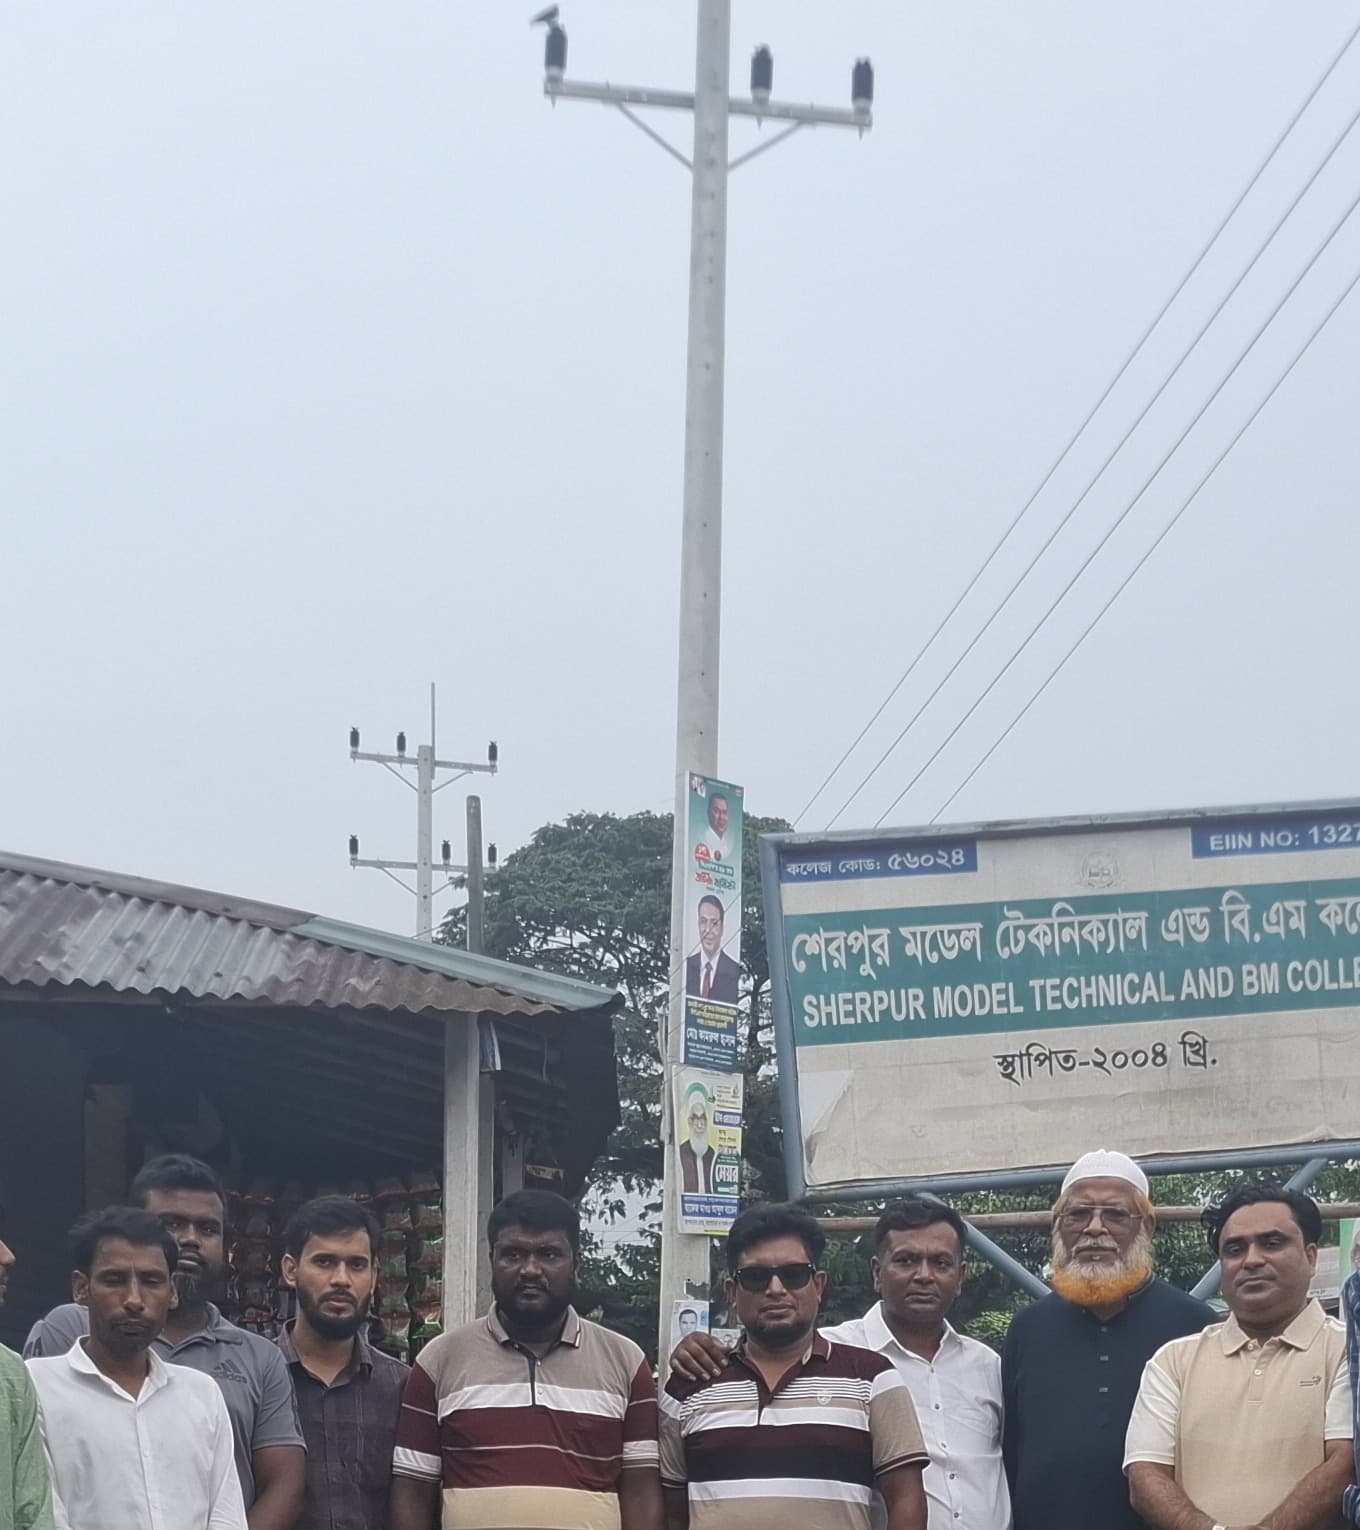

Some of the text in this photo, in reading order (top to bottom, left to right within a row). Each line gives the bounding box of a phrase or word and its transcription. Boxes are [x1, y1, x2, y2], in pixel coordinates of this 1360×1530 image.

[786, 860, 833, 876] কলেজ
[887, 848, 965, 870] ৫৬০২৪
[1209, 832, 1253, 851] EIIN
[1259, 830, 1300, 848] NO:
[791, 923, 892, 981] শেরপুর
[897, 922, 984, 967] মডেল
[995, 901, 1150, 959] টেকনিক্যাল
[1160, 906, 1211, 948] এন্ড
[1218, 889, 1307, 944] বি.এম
[803, 987, 927, 1028] SHERPUR
[932, 981, 1024, 1019] MODEL
[1028, 970, 1175, 1012] TECHNICAL
[1180, 965, 1234, 1002] AND
[1241, 962, 1280, 996] BM
[992, 1030, 1218, 1087] স্থাপিত-২০০৪ খ্রি.
